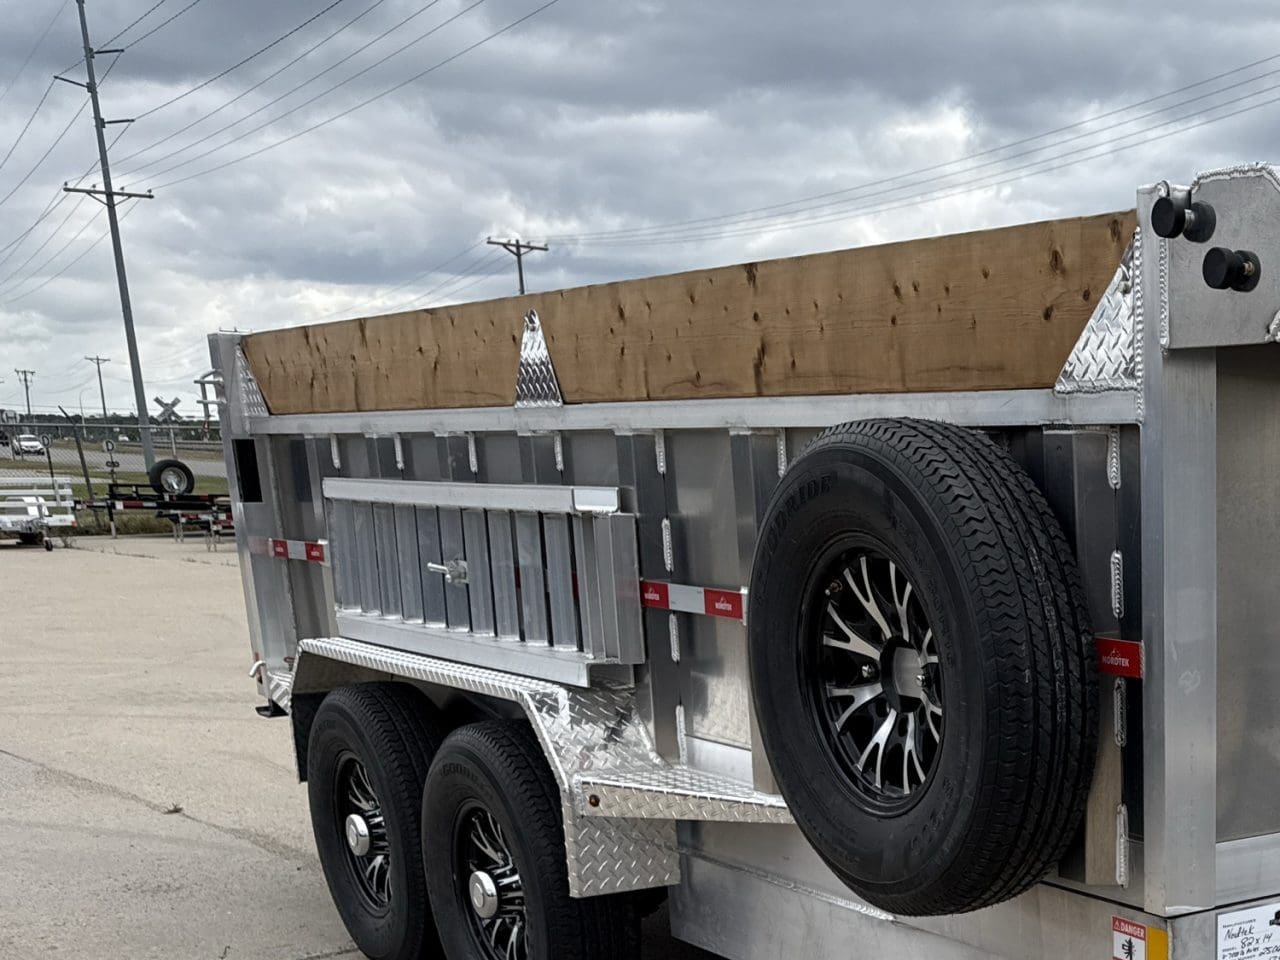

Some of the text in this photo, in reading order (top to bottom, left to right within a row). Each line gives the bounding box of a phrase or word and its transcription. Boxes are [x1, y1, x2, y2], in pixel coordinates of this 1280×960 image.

[105, 441, 114, 452] D
[1102, 655, 1130, 668] NORDTEK
[1120, 922, 1145, 938] DANGER
